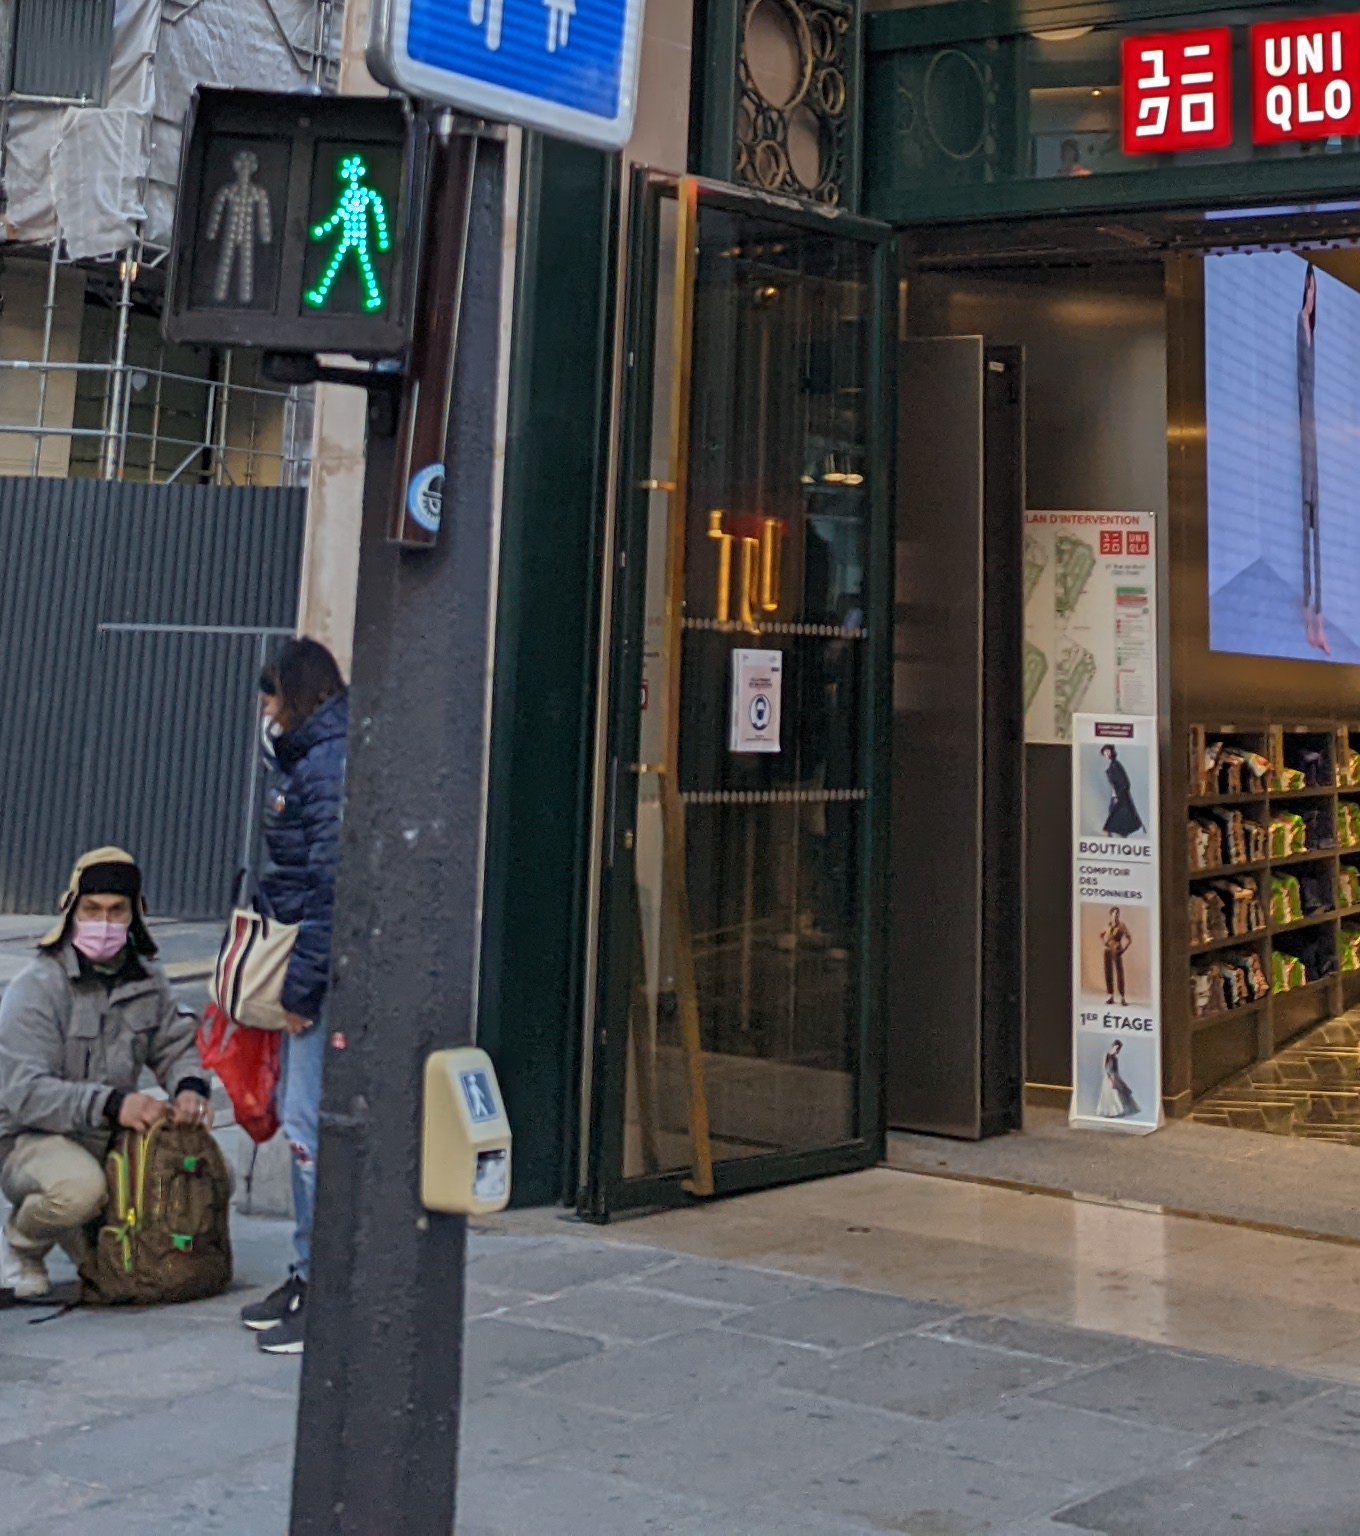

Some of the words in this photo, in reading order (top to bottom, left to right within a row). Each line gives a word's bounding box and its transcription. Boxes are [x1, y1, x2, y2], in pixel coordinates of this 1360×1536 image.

[1264, 30, 1342, 77] UNI
[1265, 78, 1351, 132] QLO
[1025, 514, 1048, 524] LAN
[1050, 514, 1140, 525] D'INTERVENTION
[1128, 533, 1146, 542] UNI
[1128, 543, 1148, 553] QLO
[1079, 842, 1152, 857] BOUTIQUE
[1079, 865, 1131, 876] COMPTOIR
[1079, 876, 1098, 885] DES
[1079, 887, 1143, 899] COTONNIERS
[1102, 1011, 1154, 1031] ÉTAGE
